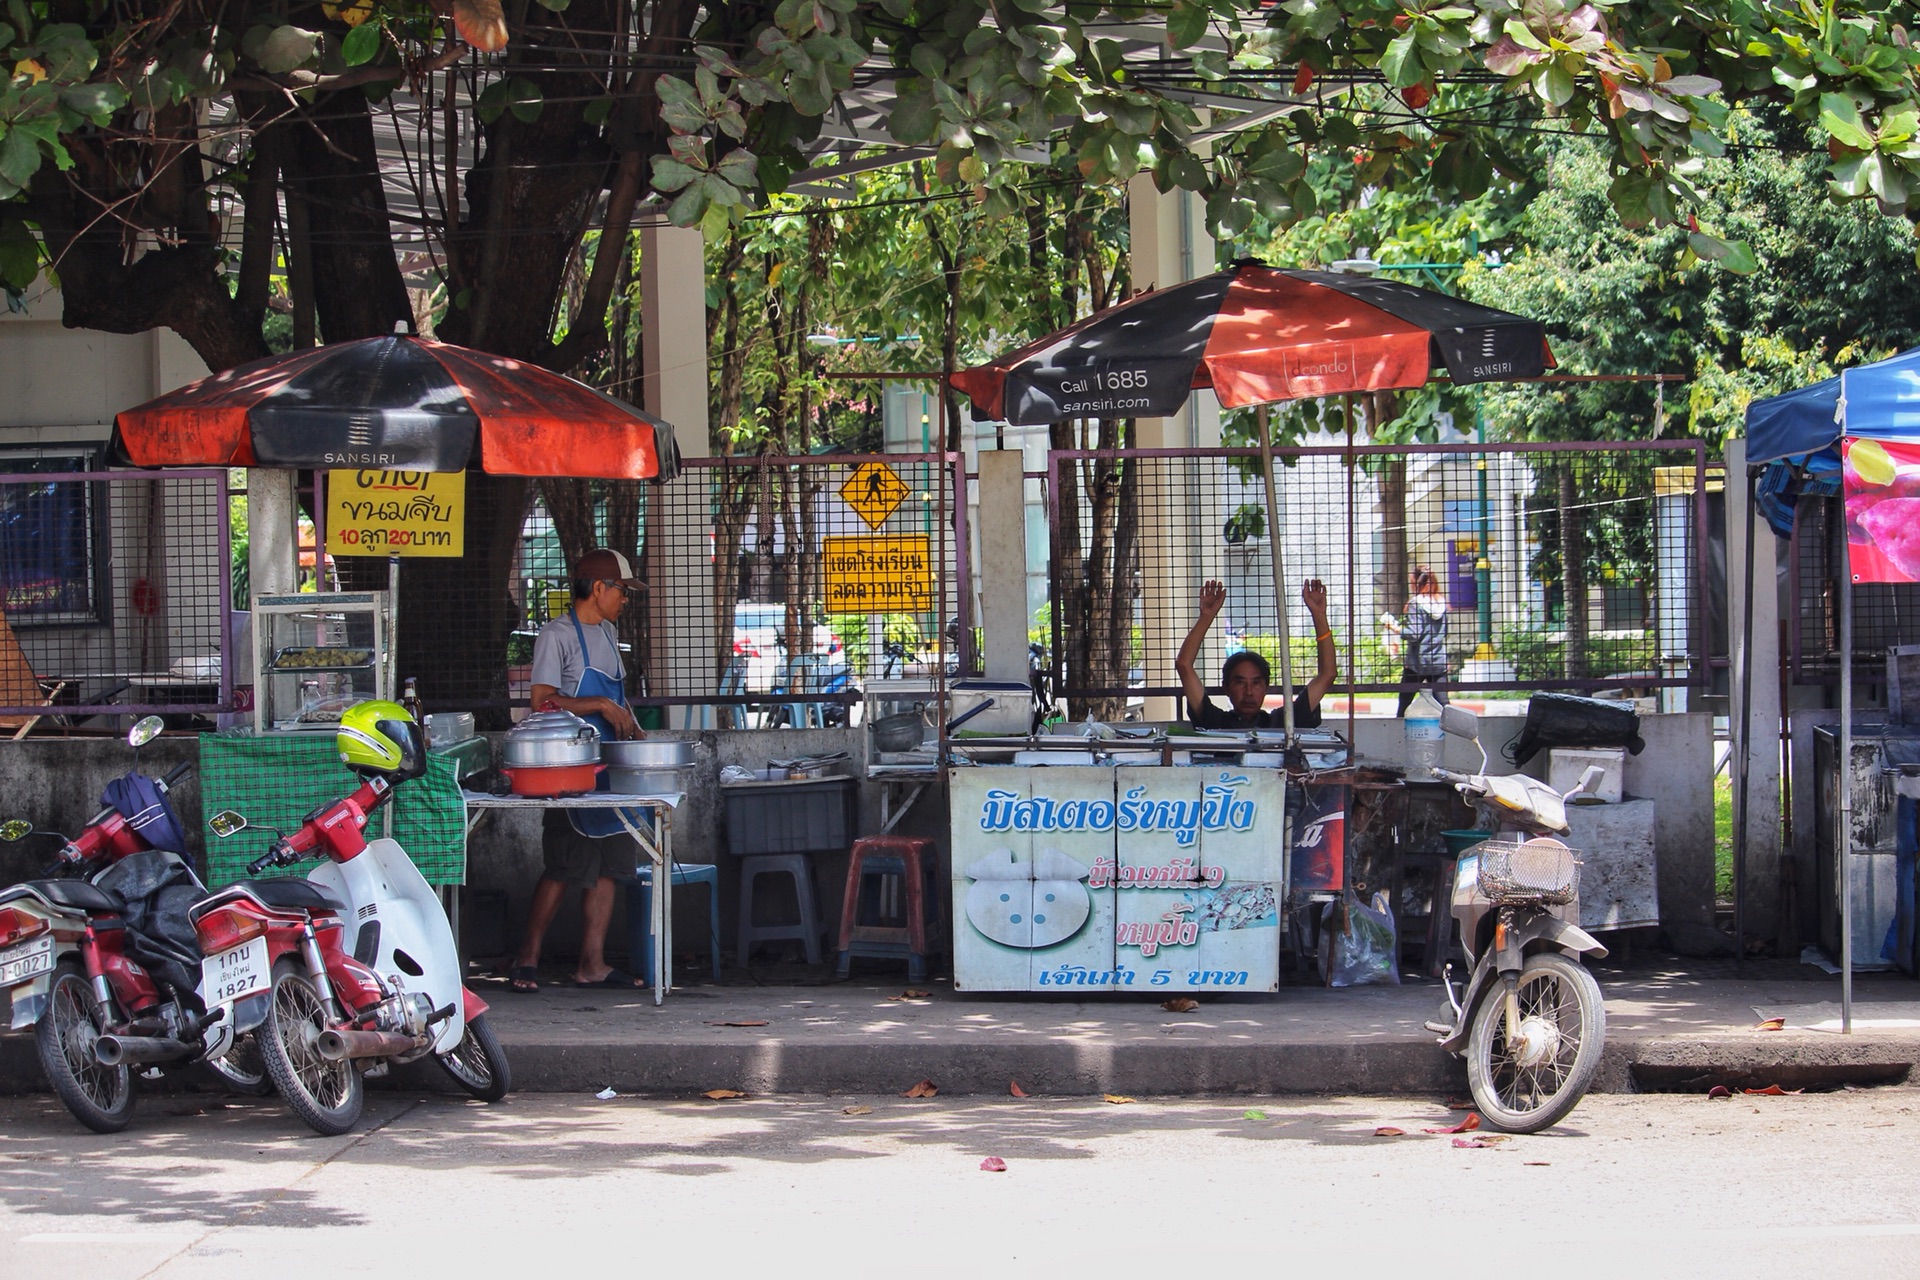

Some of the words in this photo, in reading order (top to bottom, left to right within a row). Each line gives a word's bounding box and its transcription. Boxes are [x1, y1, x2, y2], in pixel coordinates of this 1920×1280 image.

[1060, 379, 1088, 394] Call
[1094, 369, 1148, 391] 1685
[1473, 362, 1513, 378] SANSIRI
[1062, 396, 1150, 413] sansiri.com
[324, 452, 395, 464] SANSIRI
[341, 494, 452, 522] ขนมจีบ
[831, 547, 923, 572] เขตโรงเรียน
[833, 574, 924, 600] ลดความเร็ว
[980, 772, 1255, 845] มิสเตอร์หมูปิ้ง
[1088, 857, 1225, 890] ข้าวเหนียว
[1116, 902, 1199, 957] หมูปิ้ง
[218, 946, 251, 969] 1กบ
[216, 974, 258, 1000] 1827
[1039, 963, 1136, 986] เจ้าเก่า
[1150, 970, 1173, 986] 5
[1188, 969, 1249, 986] บาท
